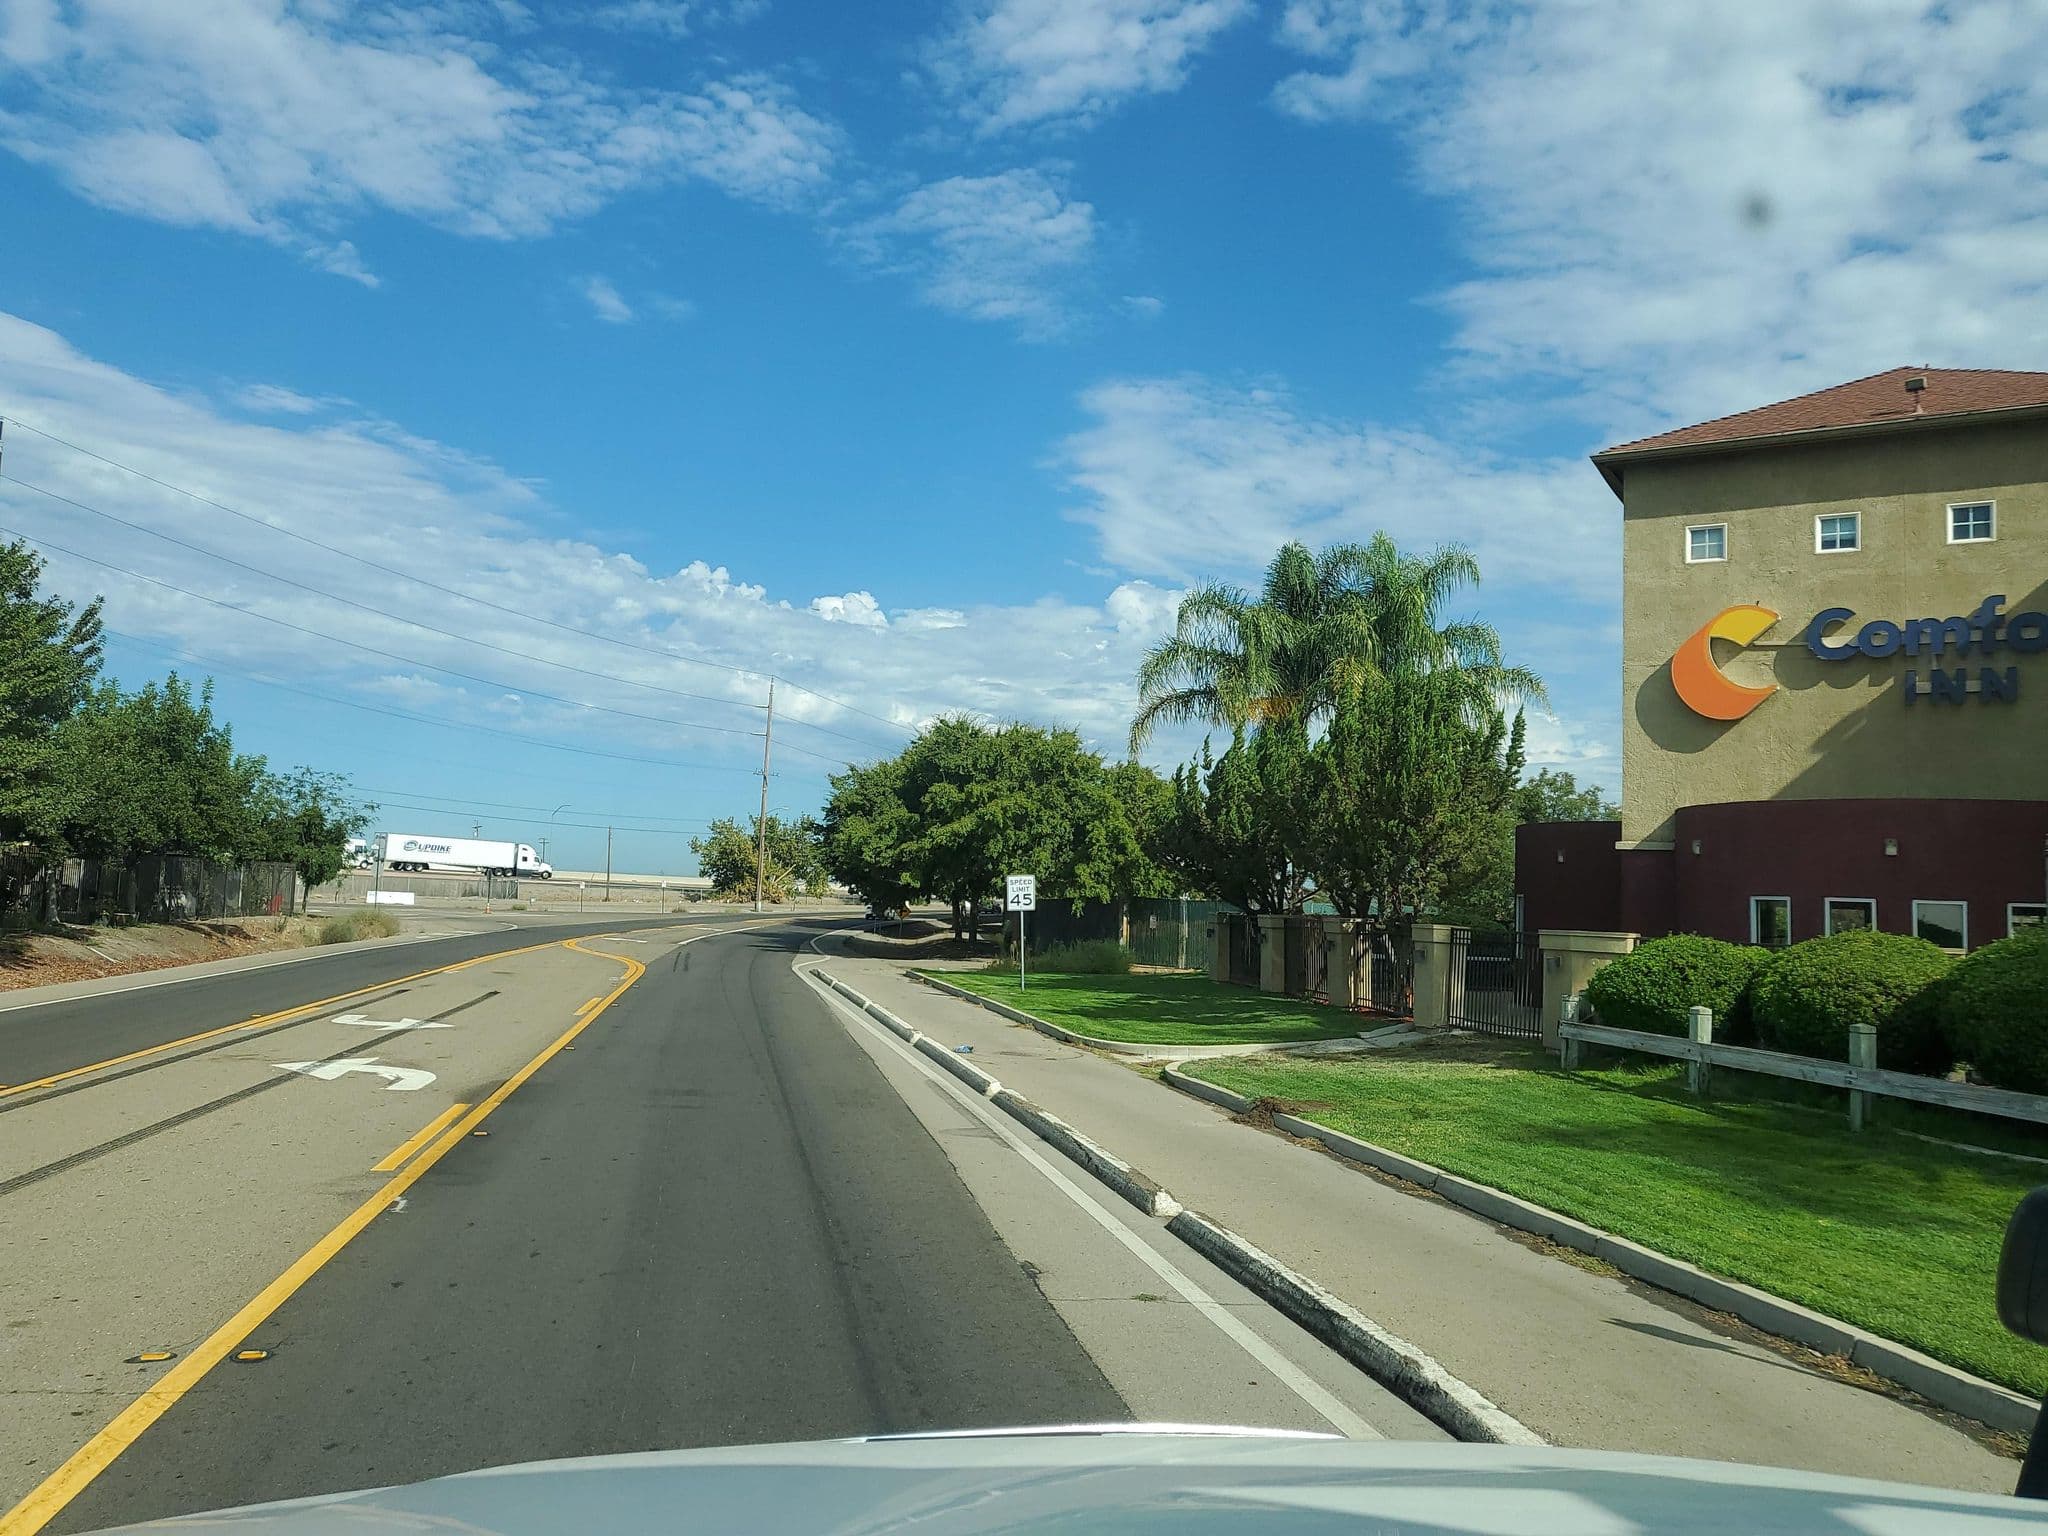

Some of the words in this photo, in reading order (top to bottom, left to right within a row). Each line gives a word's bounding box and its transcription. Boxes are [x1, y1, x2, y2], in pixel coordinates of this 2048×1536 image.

[1807, 595, 2048, 660] Comfo
[1905, 666, 2018, 706] INN
[1010, 893, 1032, 906] 45
